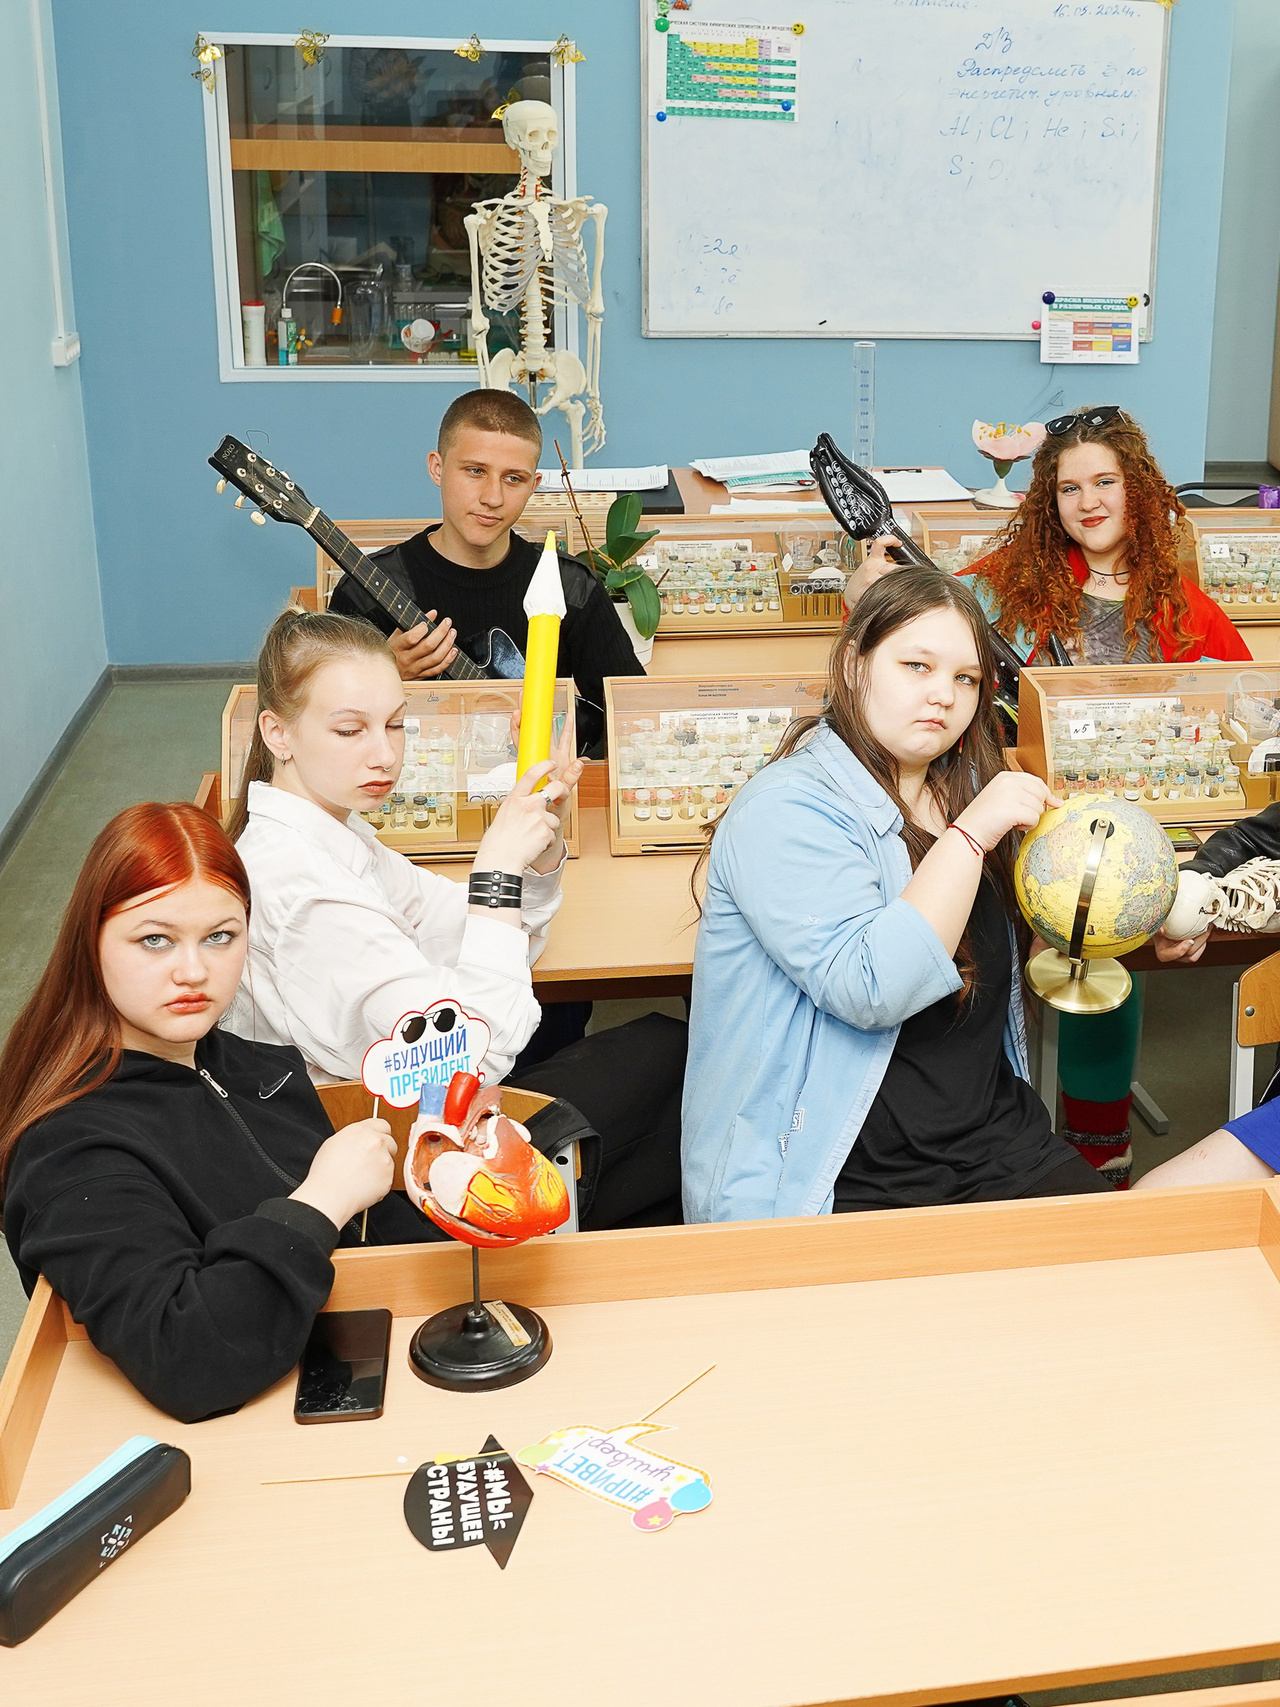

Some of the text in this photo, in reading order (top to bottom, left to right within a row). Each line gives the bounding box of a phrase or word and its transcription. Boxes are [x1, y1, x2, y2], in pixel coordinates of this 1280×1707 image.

[1126, 66, 1148, 76] по
[384, 1024, 467, 1073] #БУДУЩИЙ
[426, 1464, 456, 1547] СТРАНЫ
[455, 1460, 485, 1543] БУДУЩЕЕ
